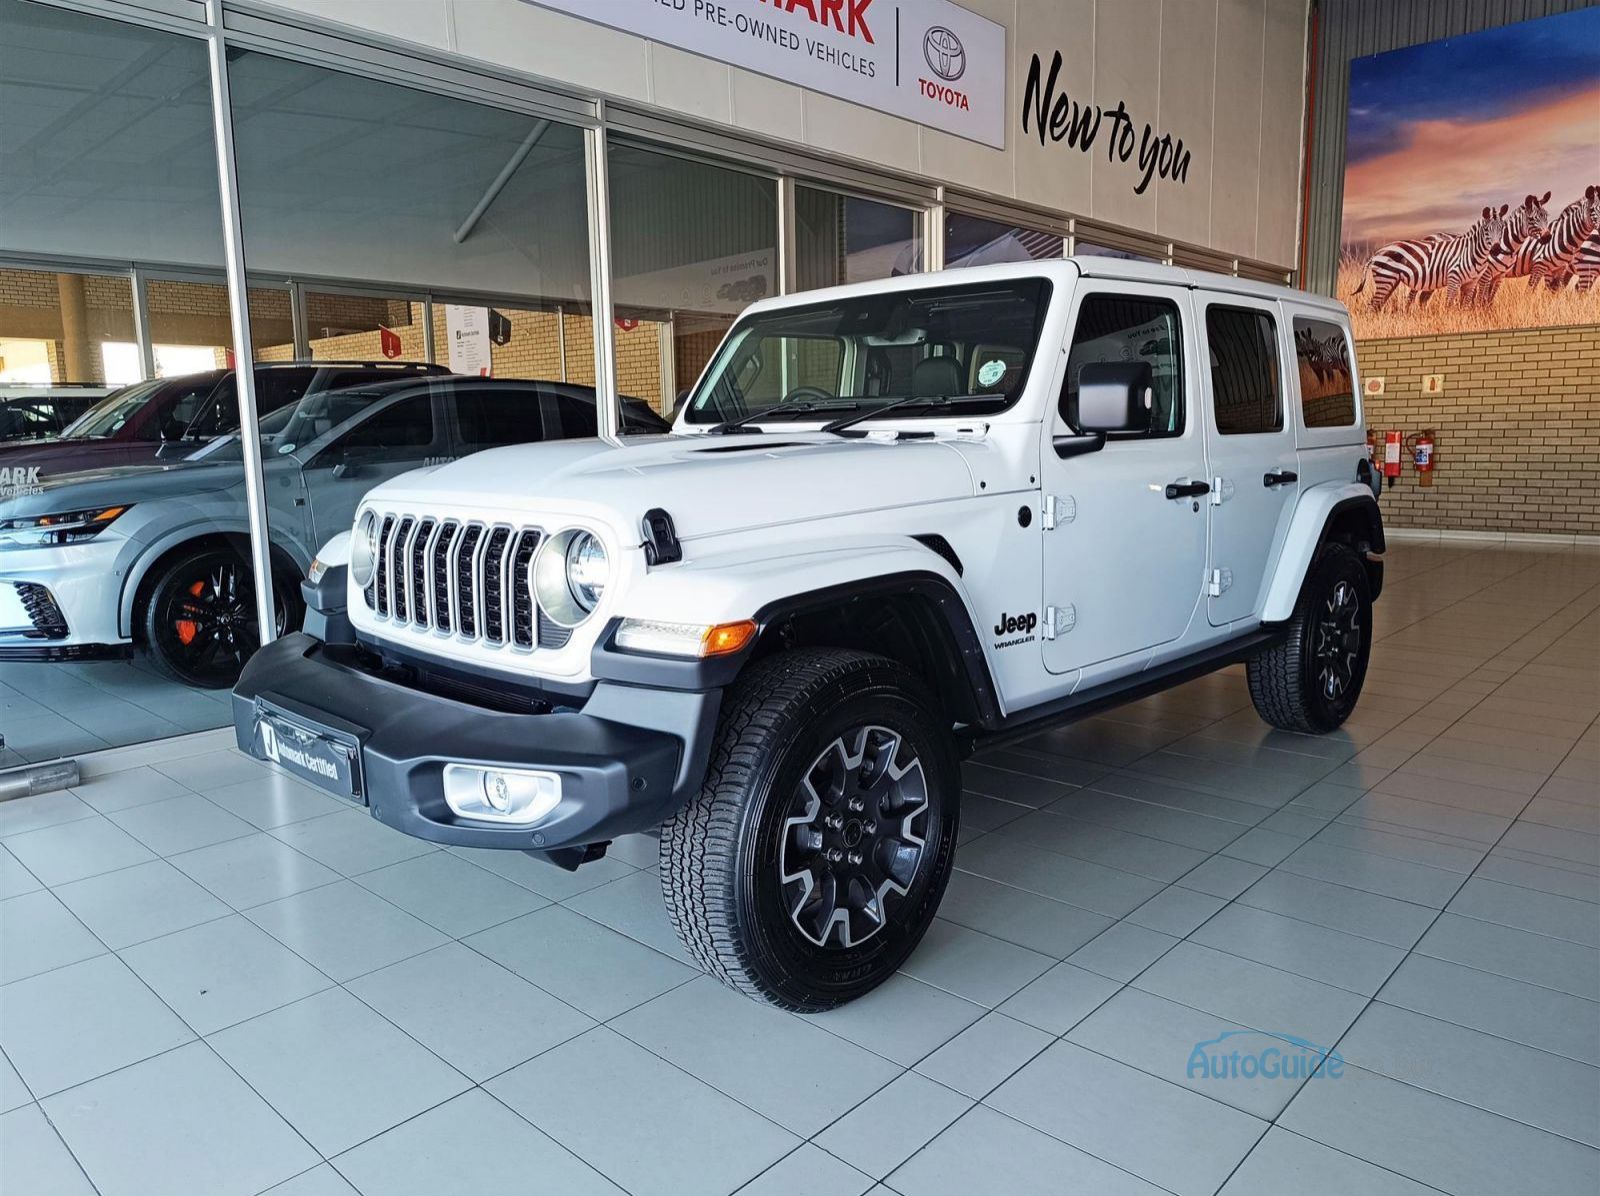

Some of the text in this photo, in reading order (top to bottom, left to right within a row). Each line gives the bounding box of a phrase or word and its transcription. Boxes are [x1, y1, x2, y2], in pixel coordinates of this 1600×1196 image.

[694, 0, 876, 78] PRE-OWNED VEHICLES
[918, 78, 970, 111] TOYOTA
[1022, 50, 1191, 195] New to you
[994, 612, 1037, 636] Jeep
[994, 635, 1035, 650] WRANGLER
